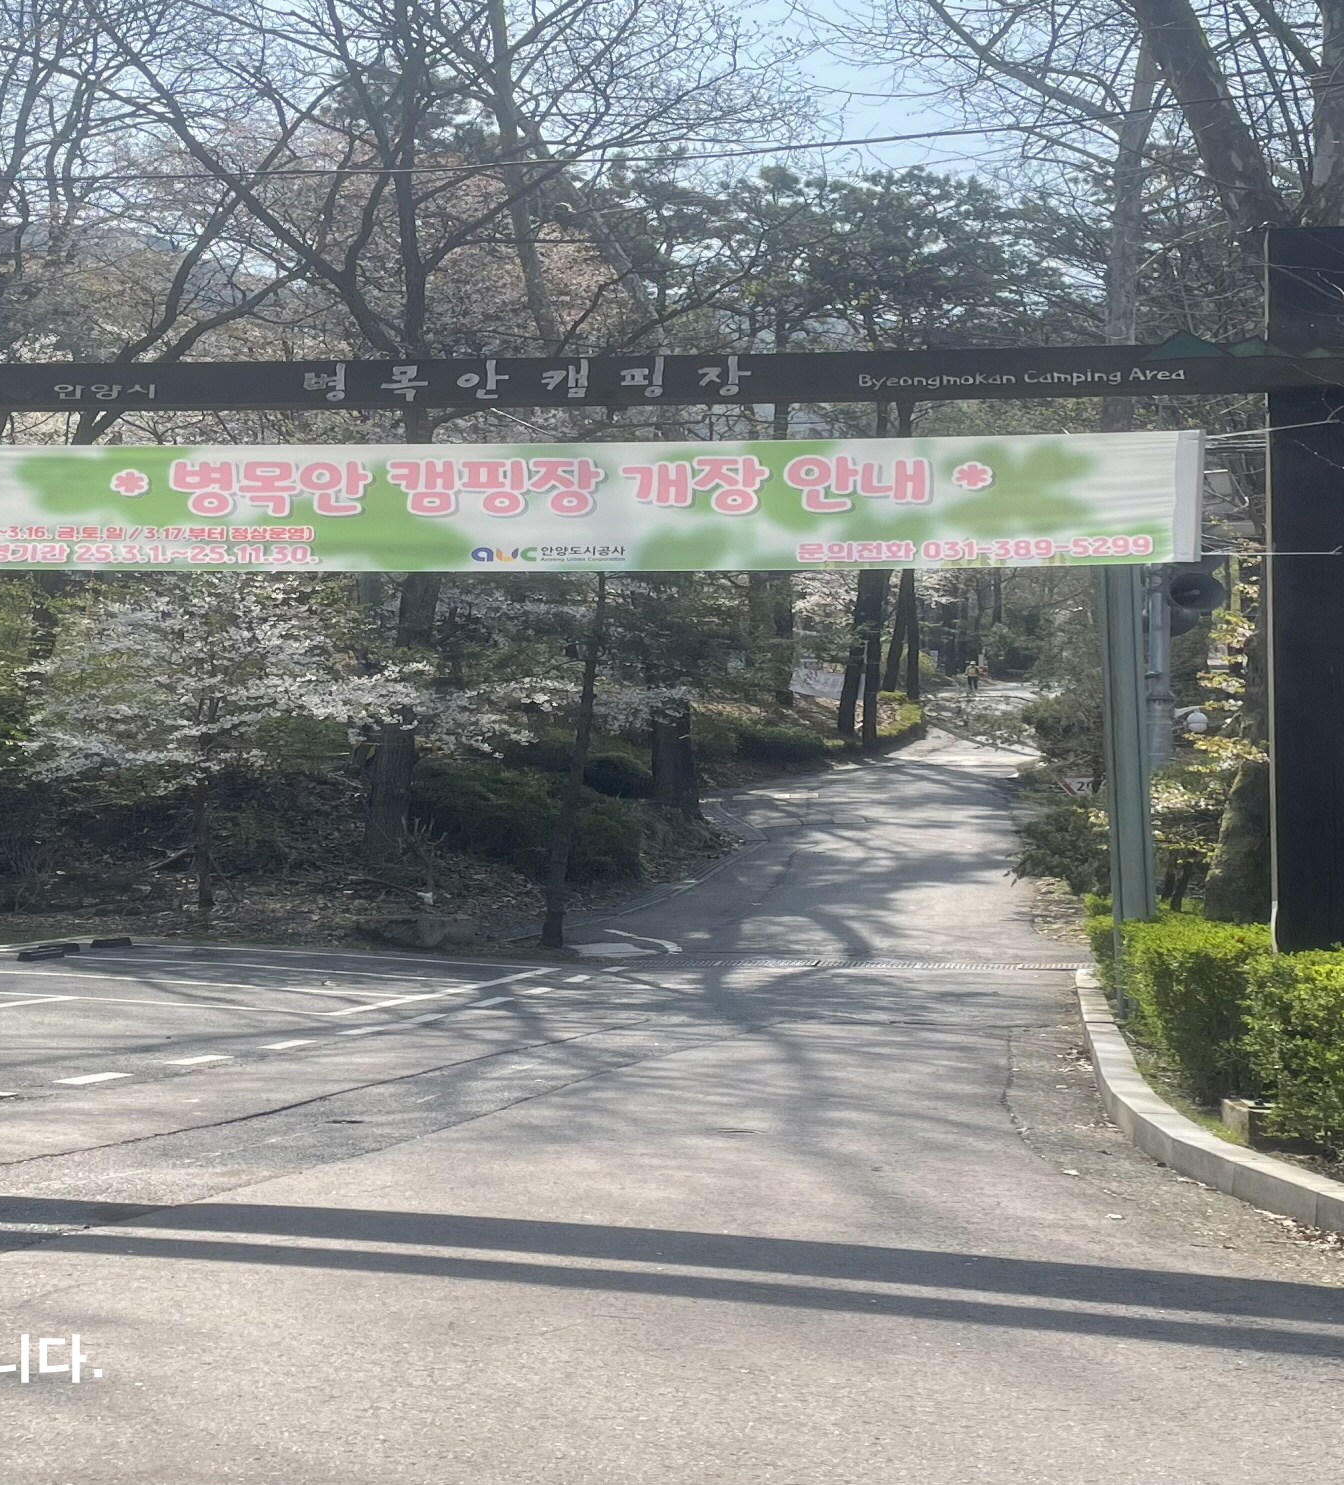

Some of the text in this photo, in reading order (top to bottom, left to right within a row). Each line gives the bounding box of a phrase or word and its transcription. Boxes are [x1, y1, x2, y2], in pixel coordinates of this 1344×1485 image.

[53, 357, 752, 401] 안양시 병목안캠핑장
[1025, 369, 1121, 386] Camping
[1129, 368, 1185, 382] Area
[173, 456, 930, 515] 병목안 캠핑장 개장 안내
[230, 527, 314, 541] 정상운영)
[74, 545, 317, 563] 25.3.1.~25.11.30.
[540, 546, 626, 556] 안양도시공사
[798, 536, 1151, 562] 문의전화 031-389-5299
